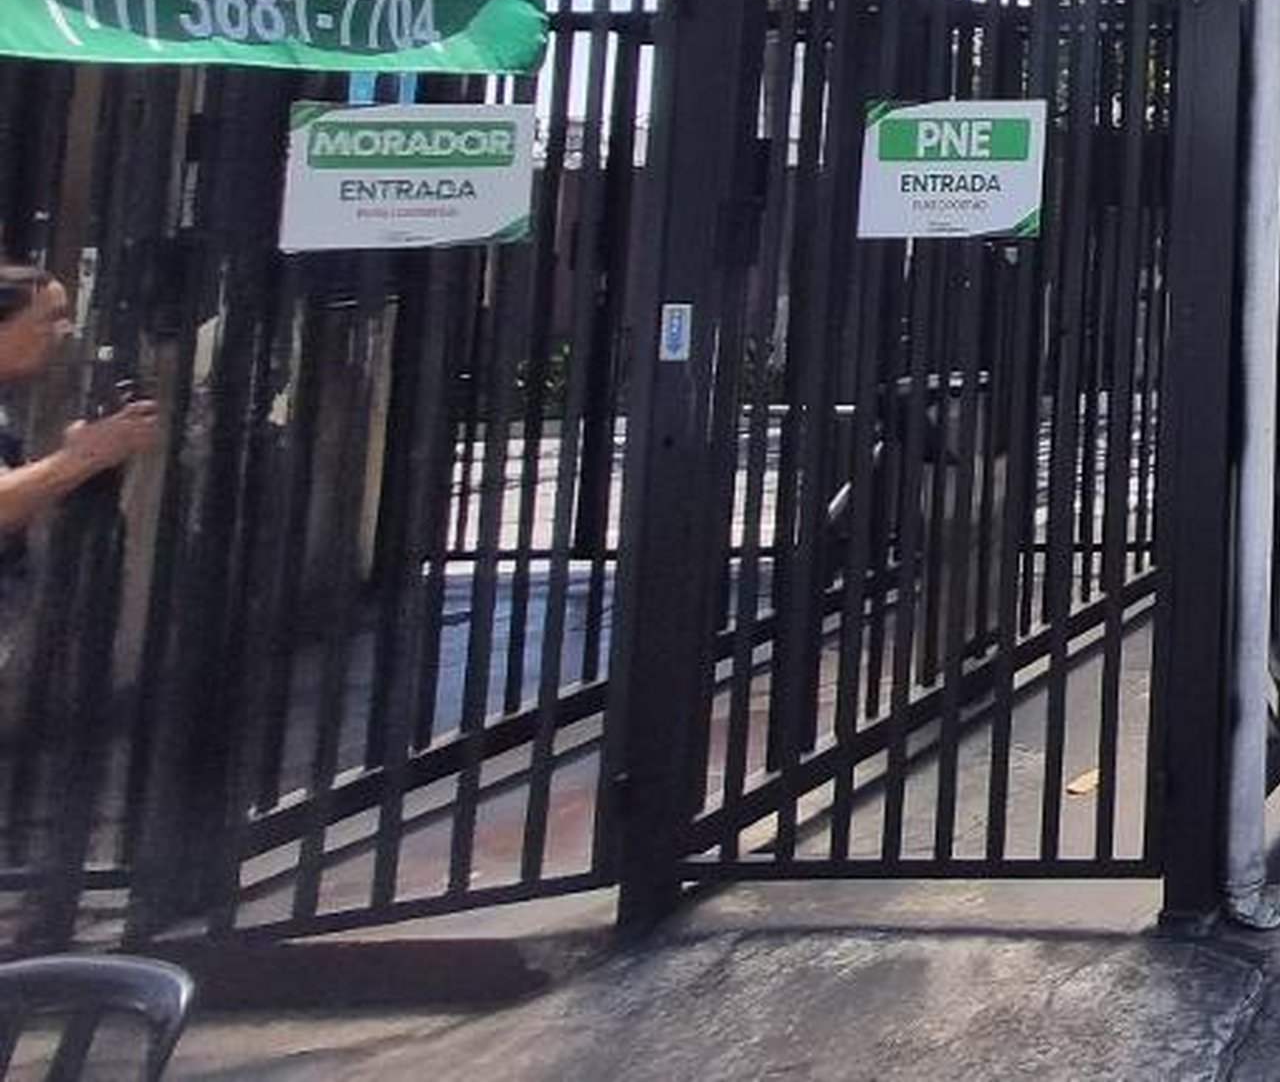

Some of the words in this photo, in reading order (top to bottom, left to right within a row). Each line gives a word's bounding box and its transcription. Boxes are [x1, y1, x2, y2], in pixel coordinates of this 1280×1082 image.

[311, 129, 512, 157] MORADOR
[916, 120, 992, 158] PNE
[340, 179, 477, 201] ENTRADA
[900, 174, 1001, 193] ENTRADA
